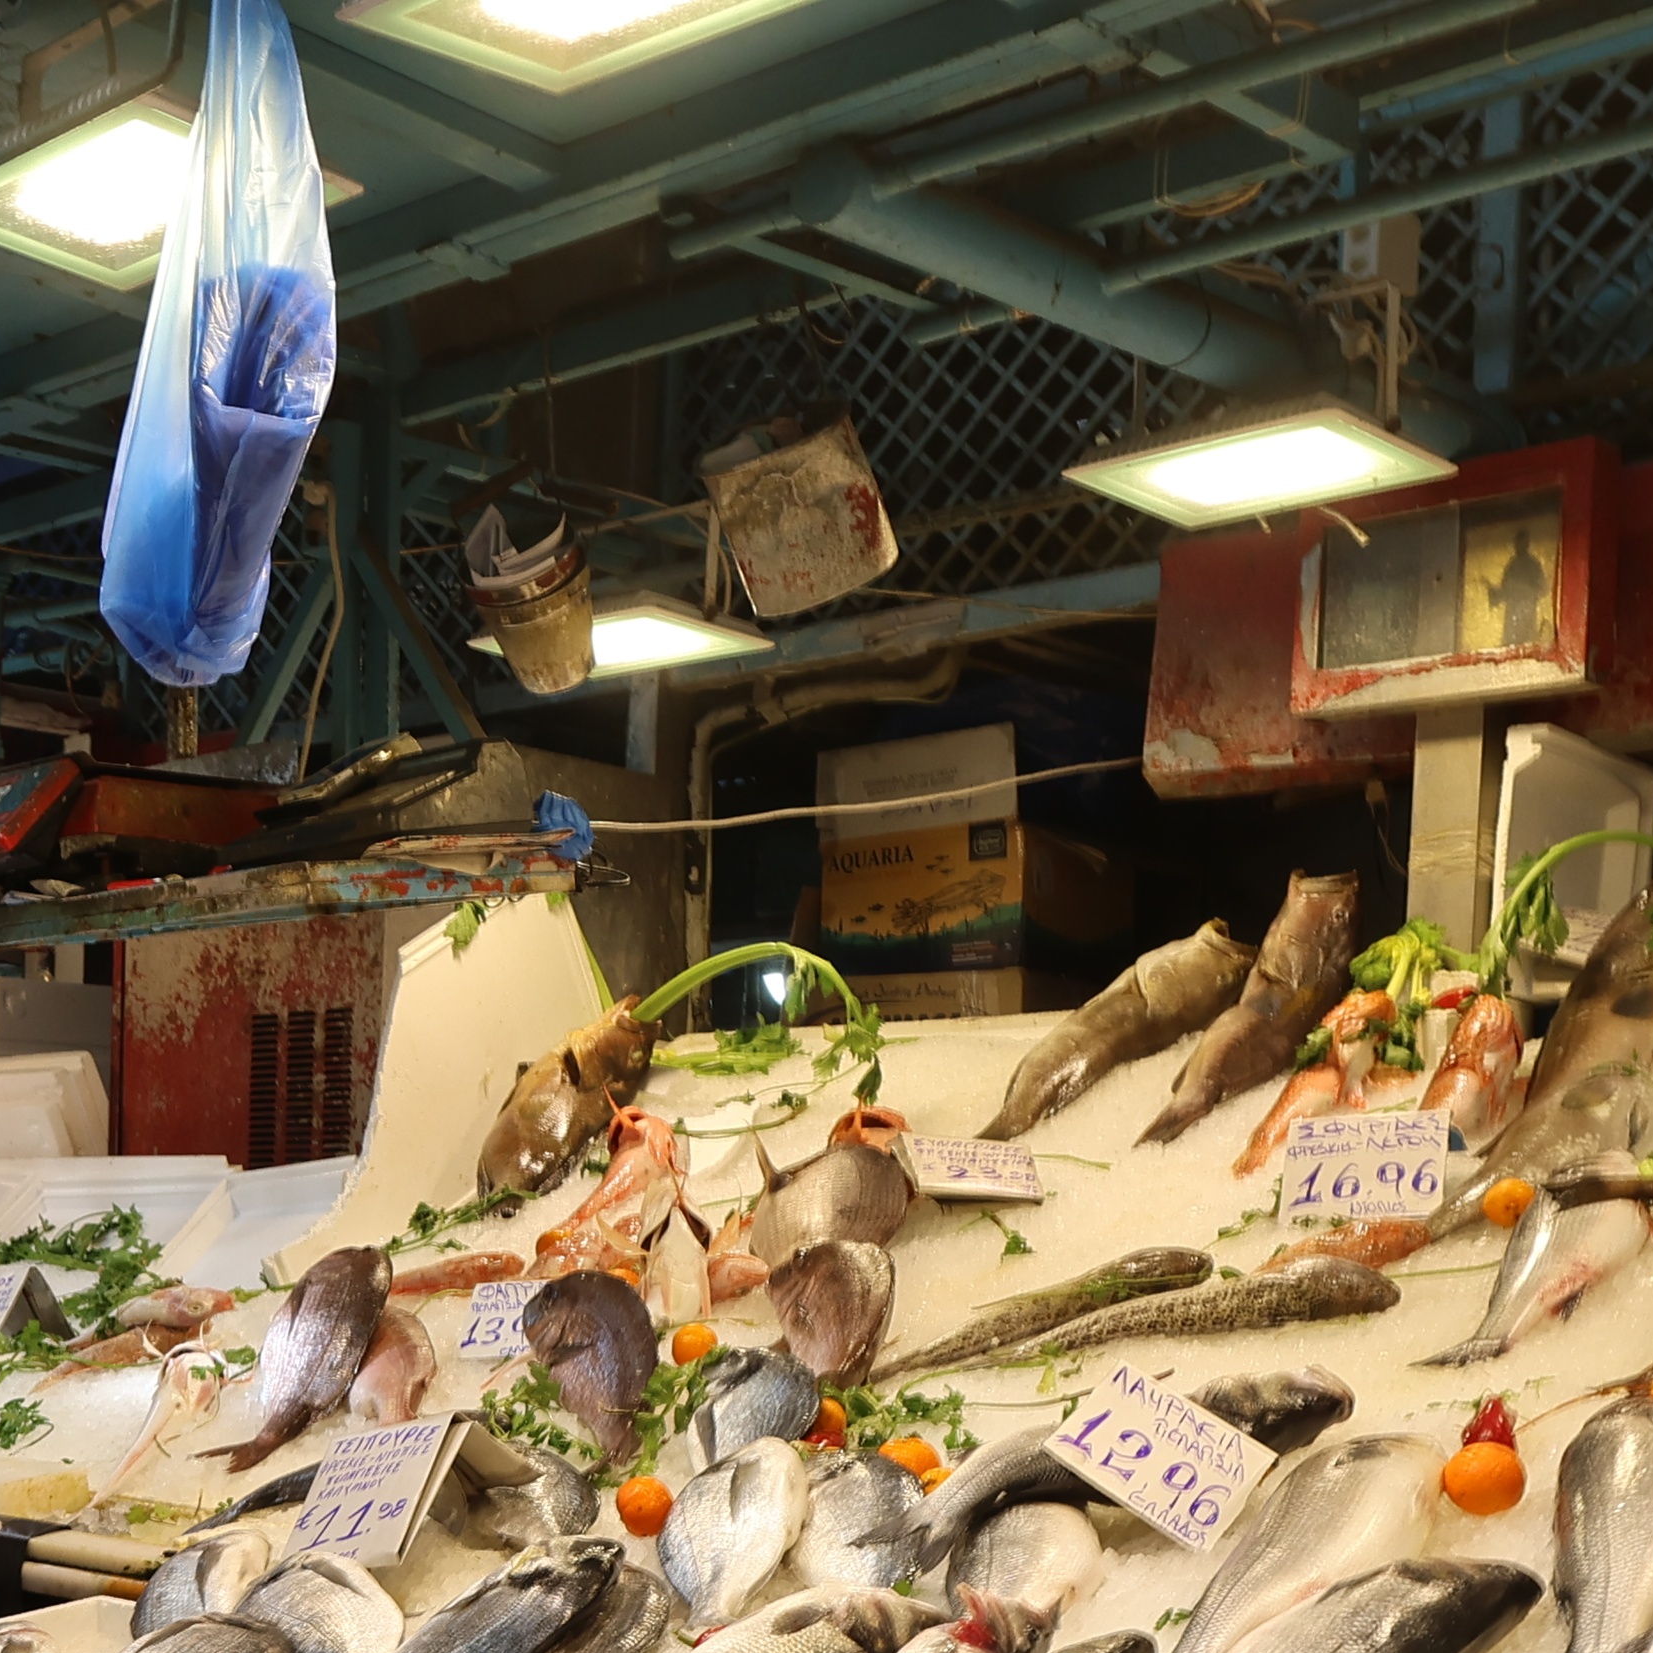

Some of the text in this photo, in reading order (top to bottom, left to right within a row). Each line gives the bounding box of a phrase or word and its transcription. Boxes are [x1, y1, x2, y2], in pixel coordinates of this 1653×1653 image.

[828, 844, 915, 874] AQUARIA
[1289, 1158, 1439, 1208] 16.96
[1055, 1408, 1232, 1527] 12.96
